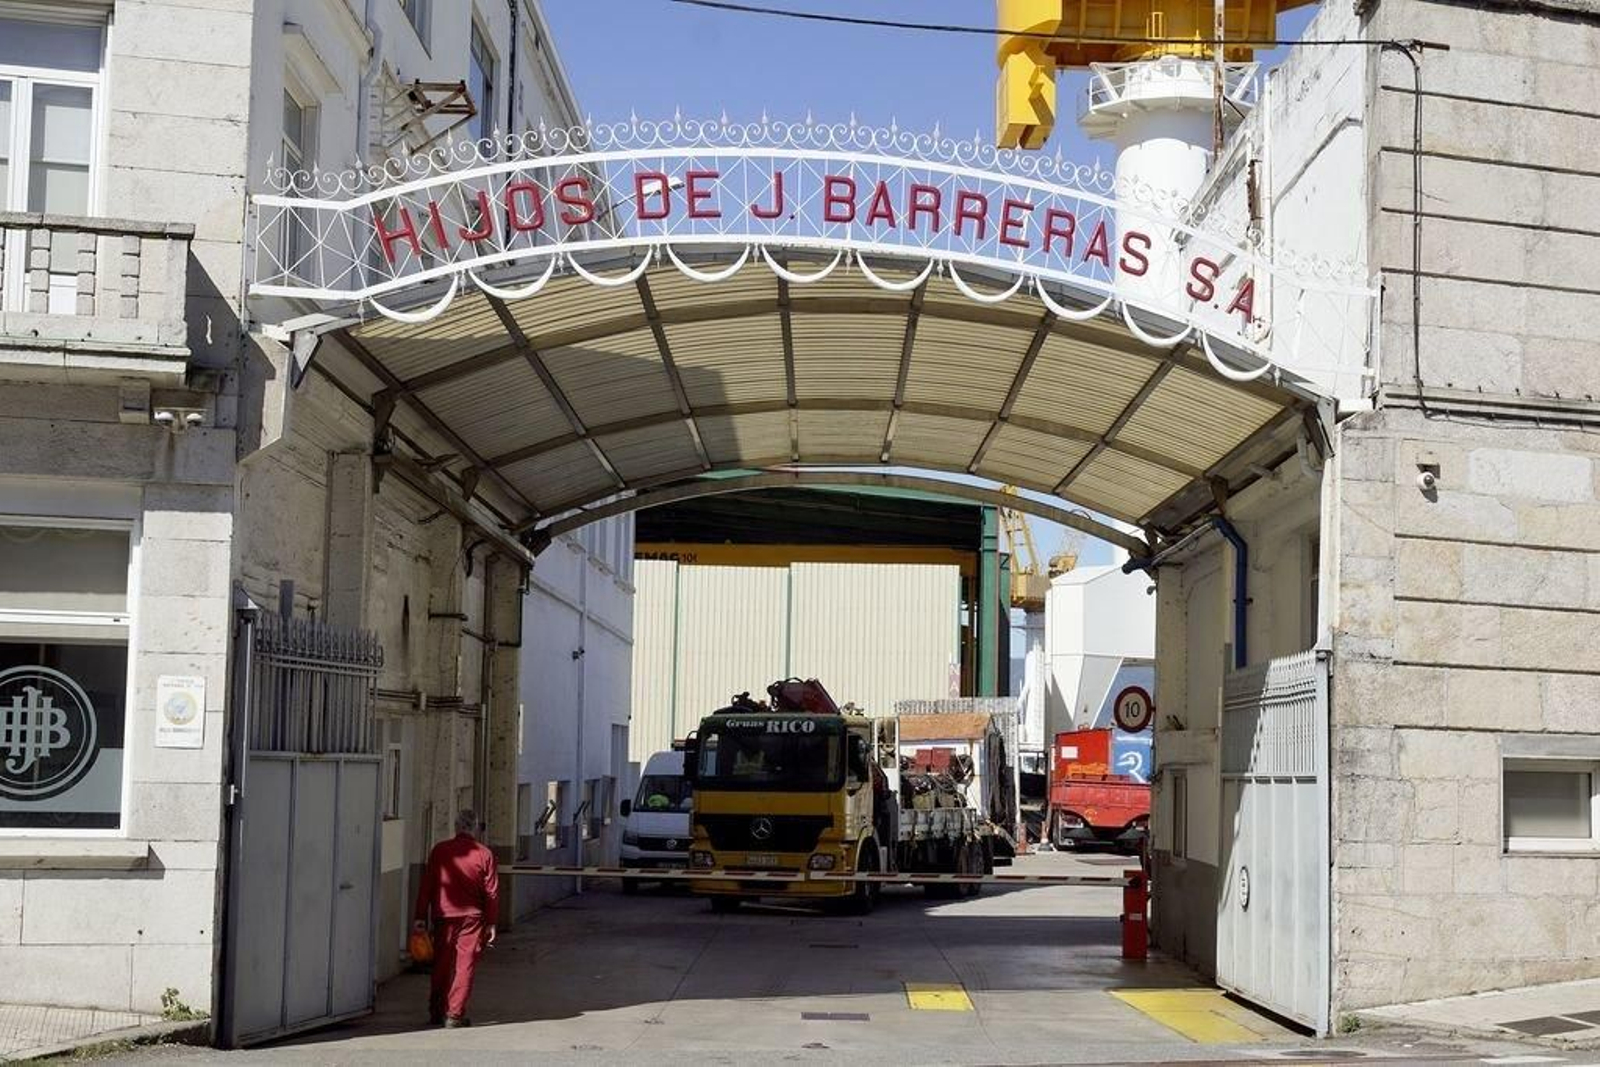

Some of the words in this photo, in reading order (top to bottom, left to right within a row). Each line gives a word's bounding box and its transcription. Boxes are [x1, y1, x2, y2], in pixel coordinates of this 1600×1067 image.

[374, 176, 599, 263] HIJOS
[634, 170, 722, 220] DE
[751, 171, 795, 220] J.
[823, 174, 1152, 277] BARRERAS
[1125, 700, 1140, 718] 10
[766, 719, 816, 734] RICO
